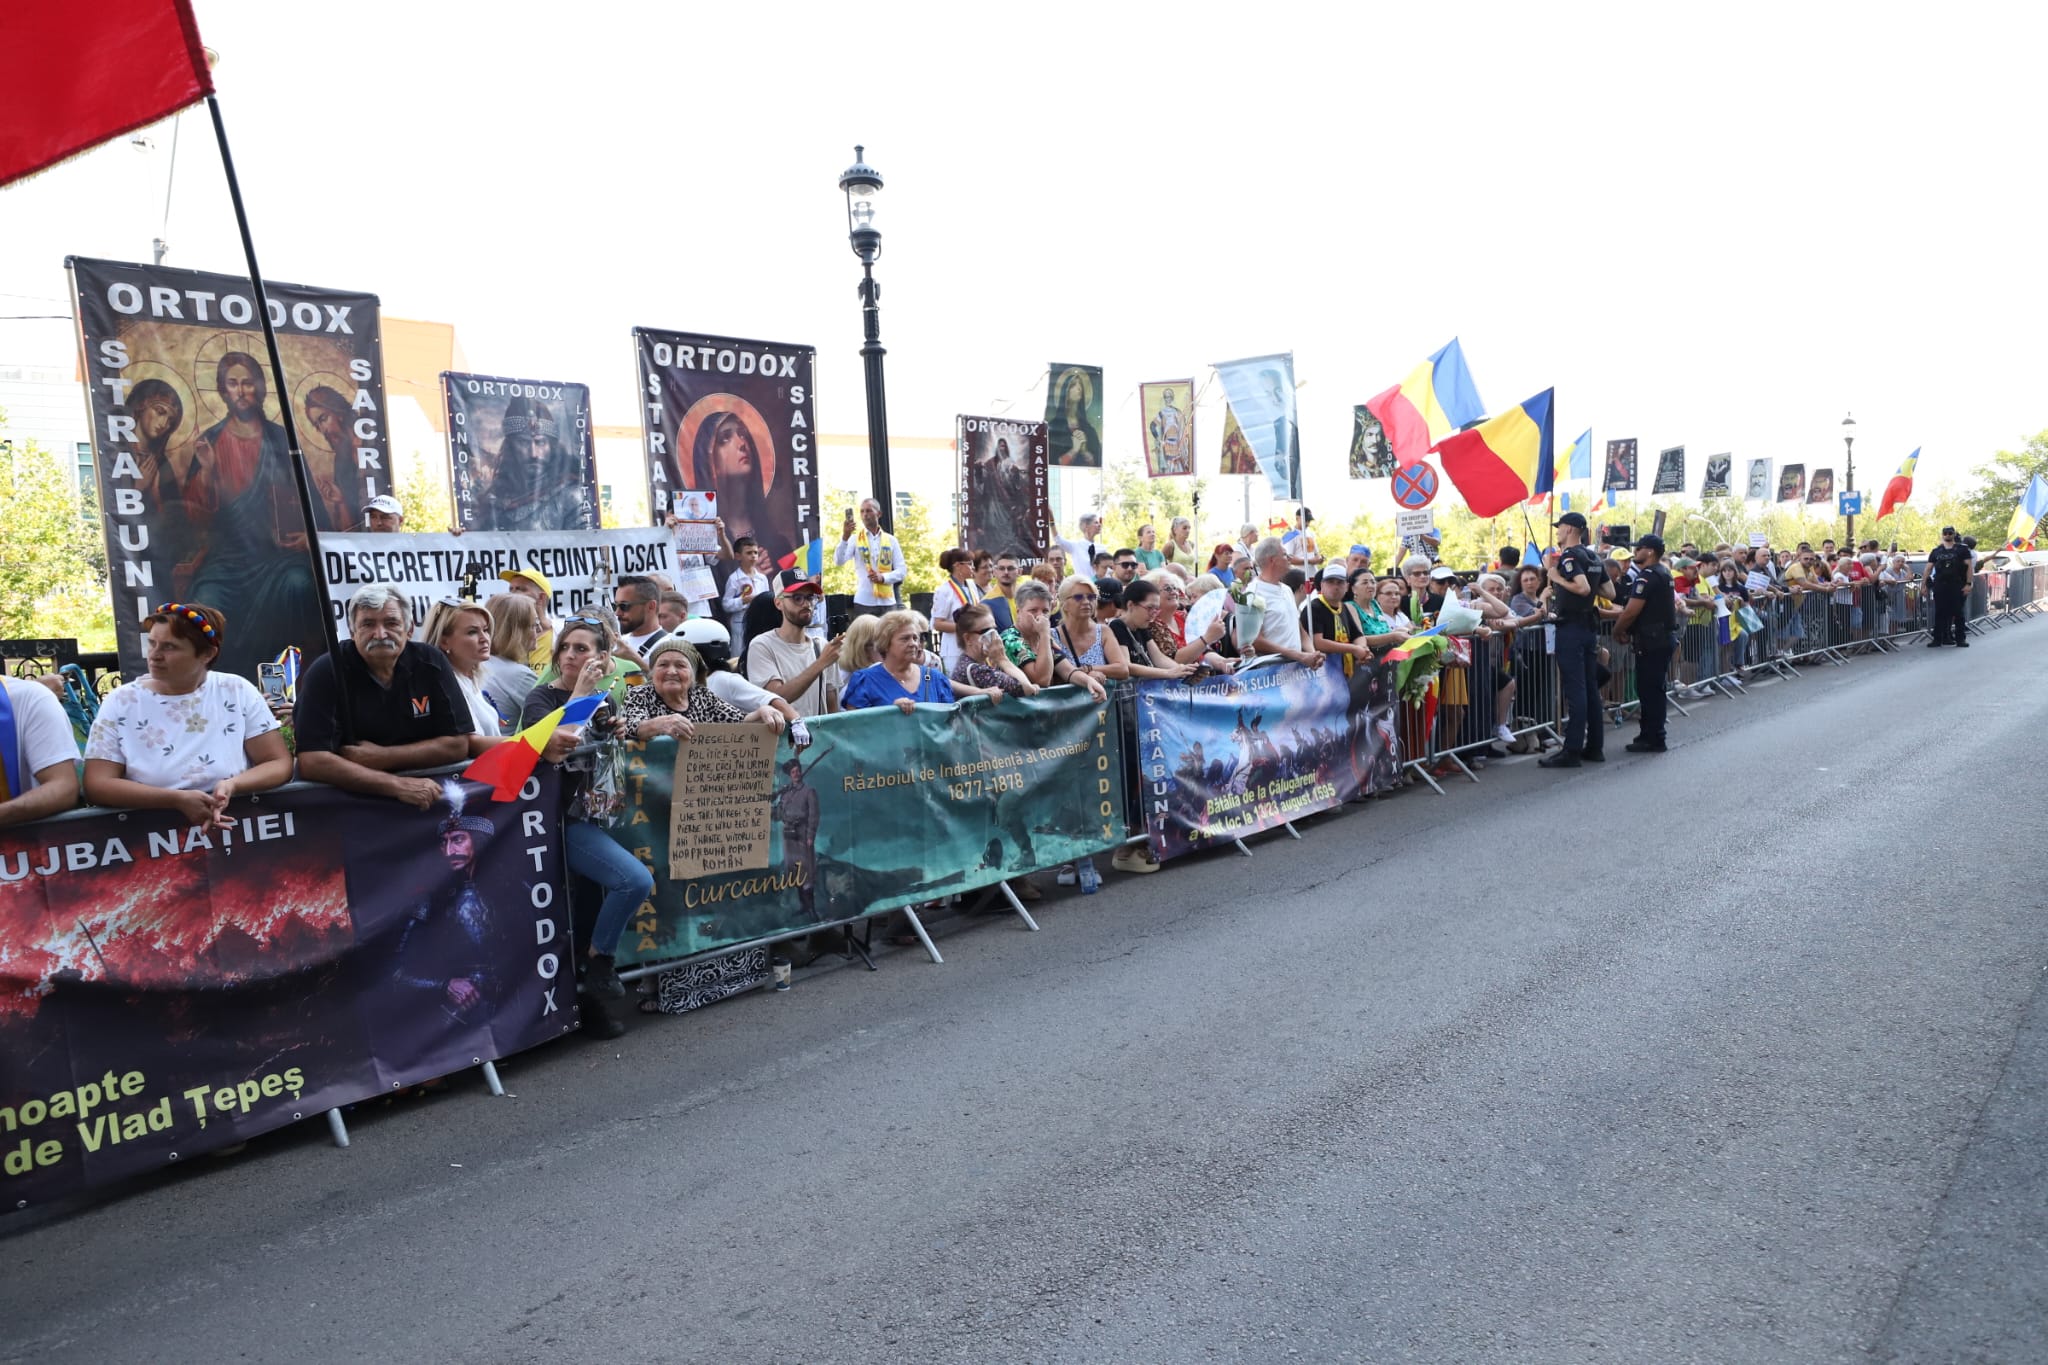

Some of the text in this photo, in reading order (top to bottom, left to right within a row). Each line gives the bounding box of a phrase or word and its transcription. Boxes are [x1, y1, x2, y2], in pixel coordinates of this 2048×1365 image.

[107, 282, 354, 334] ORTODOX
[653, 342, 797, 378] ORTODOX
[467, 380, 562, 400] ORTODOX
[967, 419, 1039, 436] ORTODOX
[455, 413, 473, 521] ONOARE
[1035, 445, 1046, 549] SACRIFICIU
[326, 542, 667, 584] DESECRETIZAREA SEDINTI CSAT
[731, 747, 760, 758] SUNT
[843, 769, 915, 792] Războiul
[919, 766, 935, 781] de
[940, 749, 1024, 779] Independență
[1025, 747, 1038, 763] al
[1145, 694, 1169, 848] STRABUNII
[687, 773, 704, 783] LOR
[1243, 789, 1255, 805] de
[1257, 785, 1267, 799] la
[1189, 829, 1199, 841] a
[1202, 822, 1225, 838] avut
[1225, 815, 1242, 831] loc
[1243, 811, 1253, 825] la
[1281, 792, 1312, 813] august
[1312, 782, 1336, 801] 1595
[147, 812, 296, 856] NAȚIEI
[702, 855, 743, 871] ROMÂN
[519, 776, 559, 1016] ORTODOX
[684, 862, 808, 909] Curcanul
[3, 1066, 305, 1176] de Vlad Țepeș
